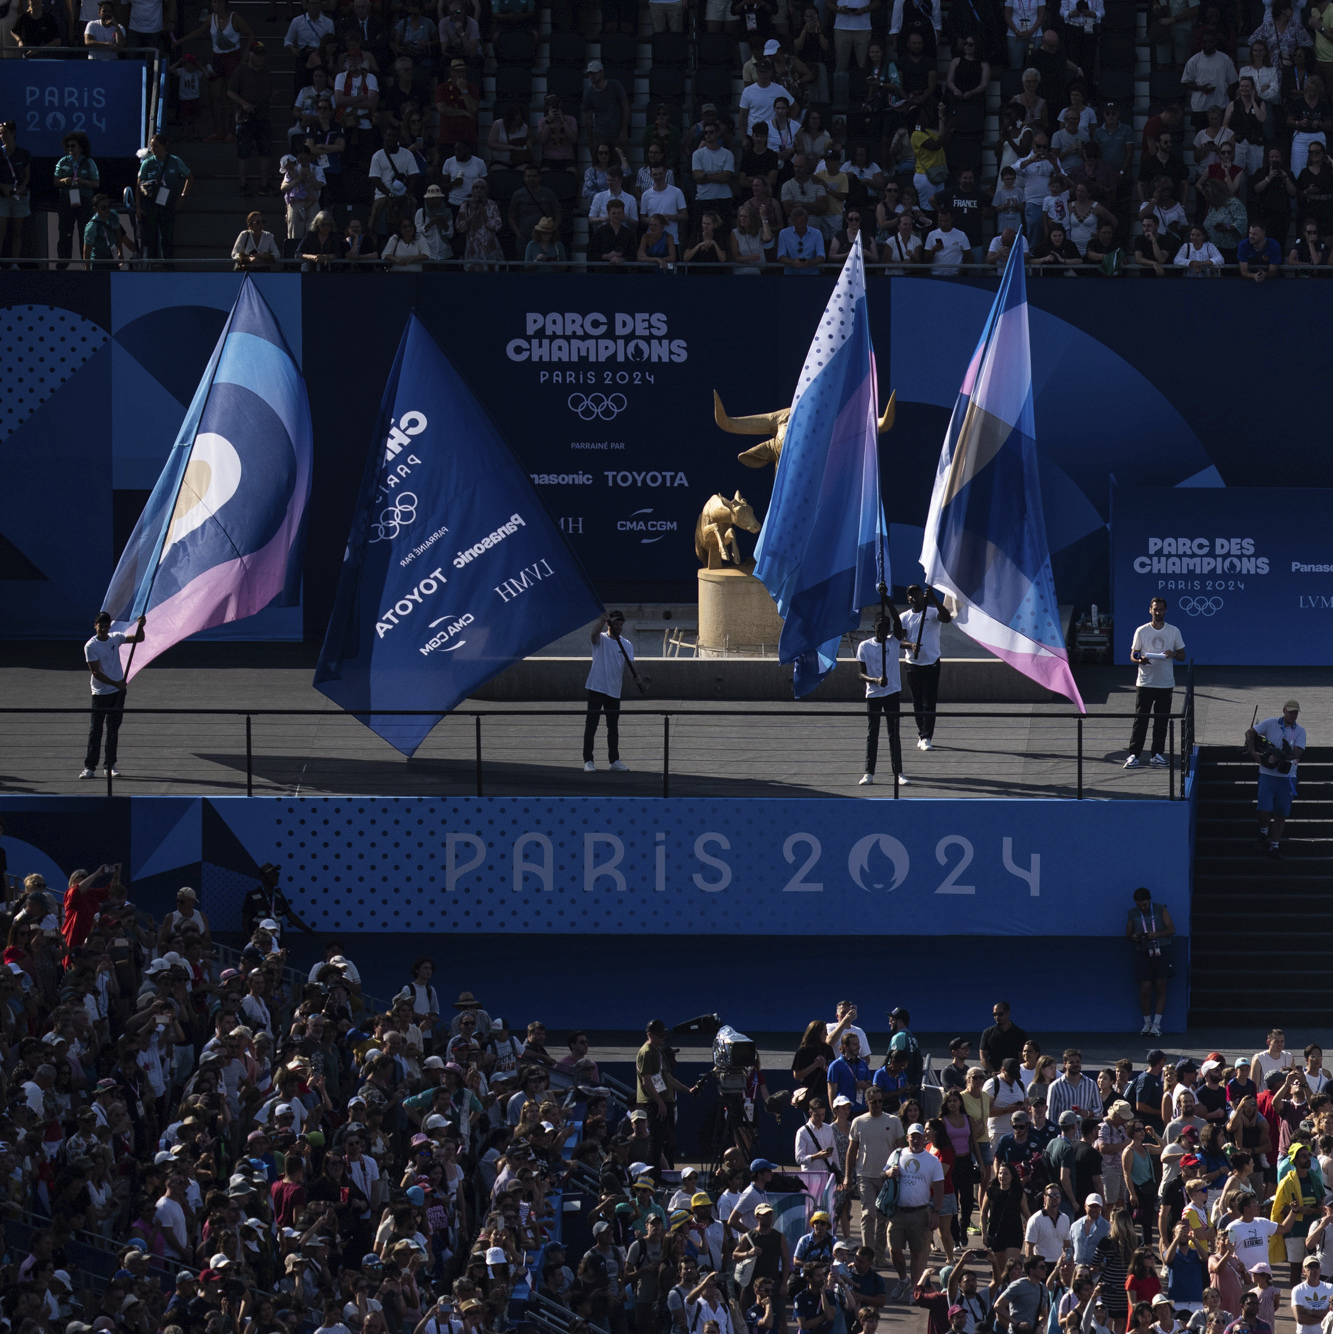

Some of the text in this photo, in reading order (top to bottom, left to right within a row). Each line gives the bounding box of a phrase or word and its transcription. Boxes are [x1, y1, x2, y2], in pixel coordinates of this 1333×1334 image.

[26, 110, 105, 133] 2024
[953, 199, 978, 208] FRANCE
[526, 312, 668, 337] PARC DES
[506, 338, 688, 363] CHAMPIONS
[603, 371, 656, 385] 2024
[570, 440, 625, 450] PARRAINÉ PAR
[531, 470, 689, 487] nasonic TOYOTA
[617, 520, 678, 531] CMA CGM
[1148, 537, 1255, 555] PARC DES
[1133, 556, 1270, 575] CHAMPIONS
[1205, 580, 1245, 591] 2024
[782, 833, 1041, 897] 2024
